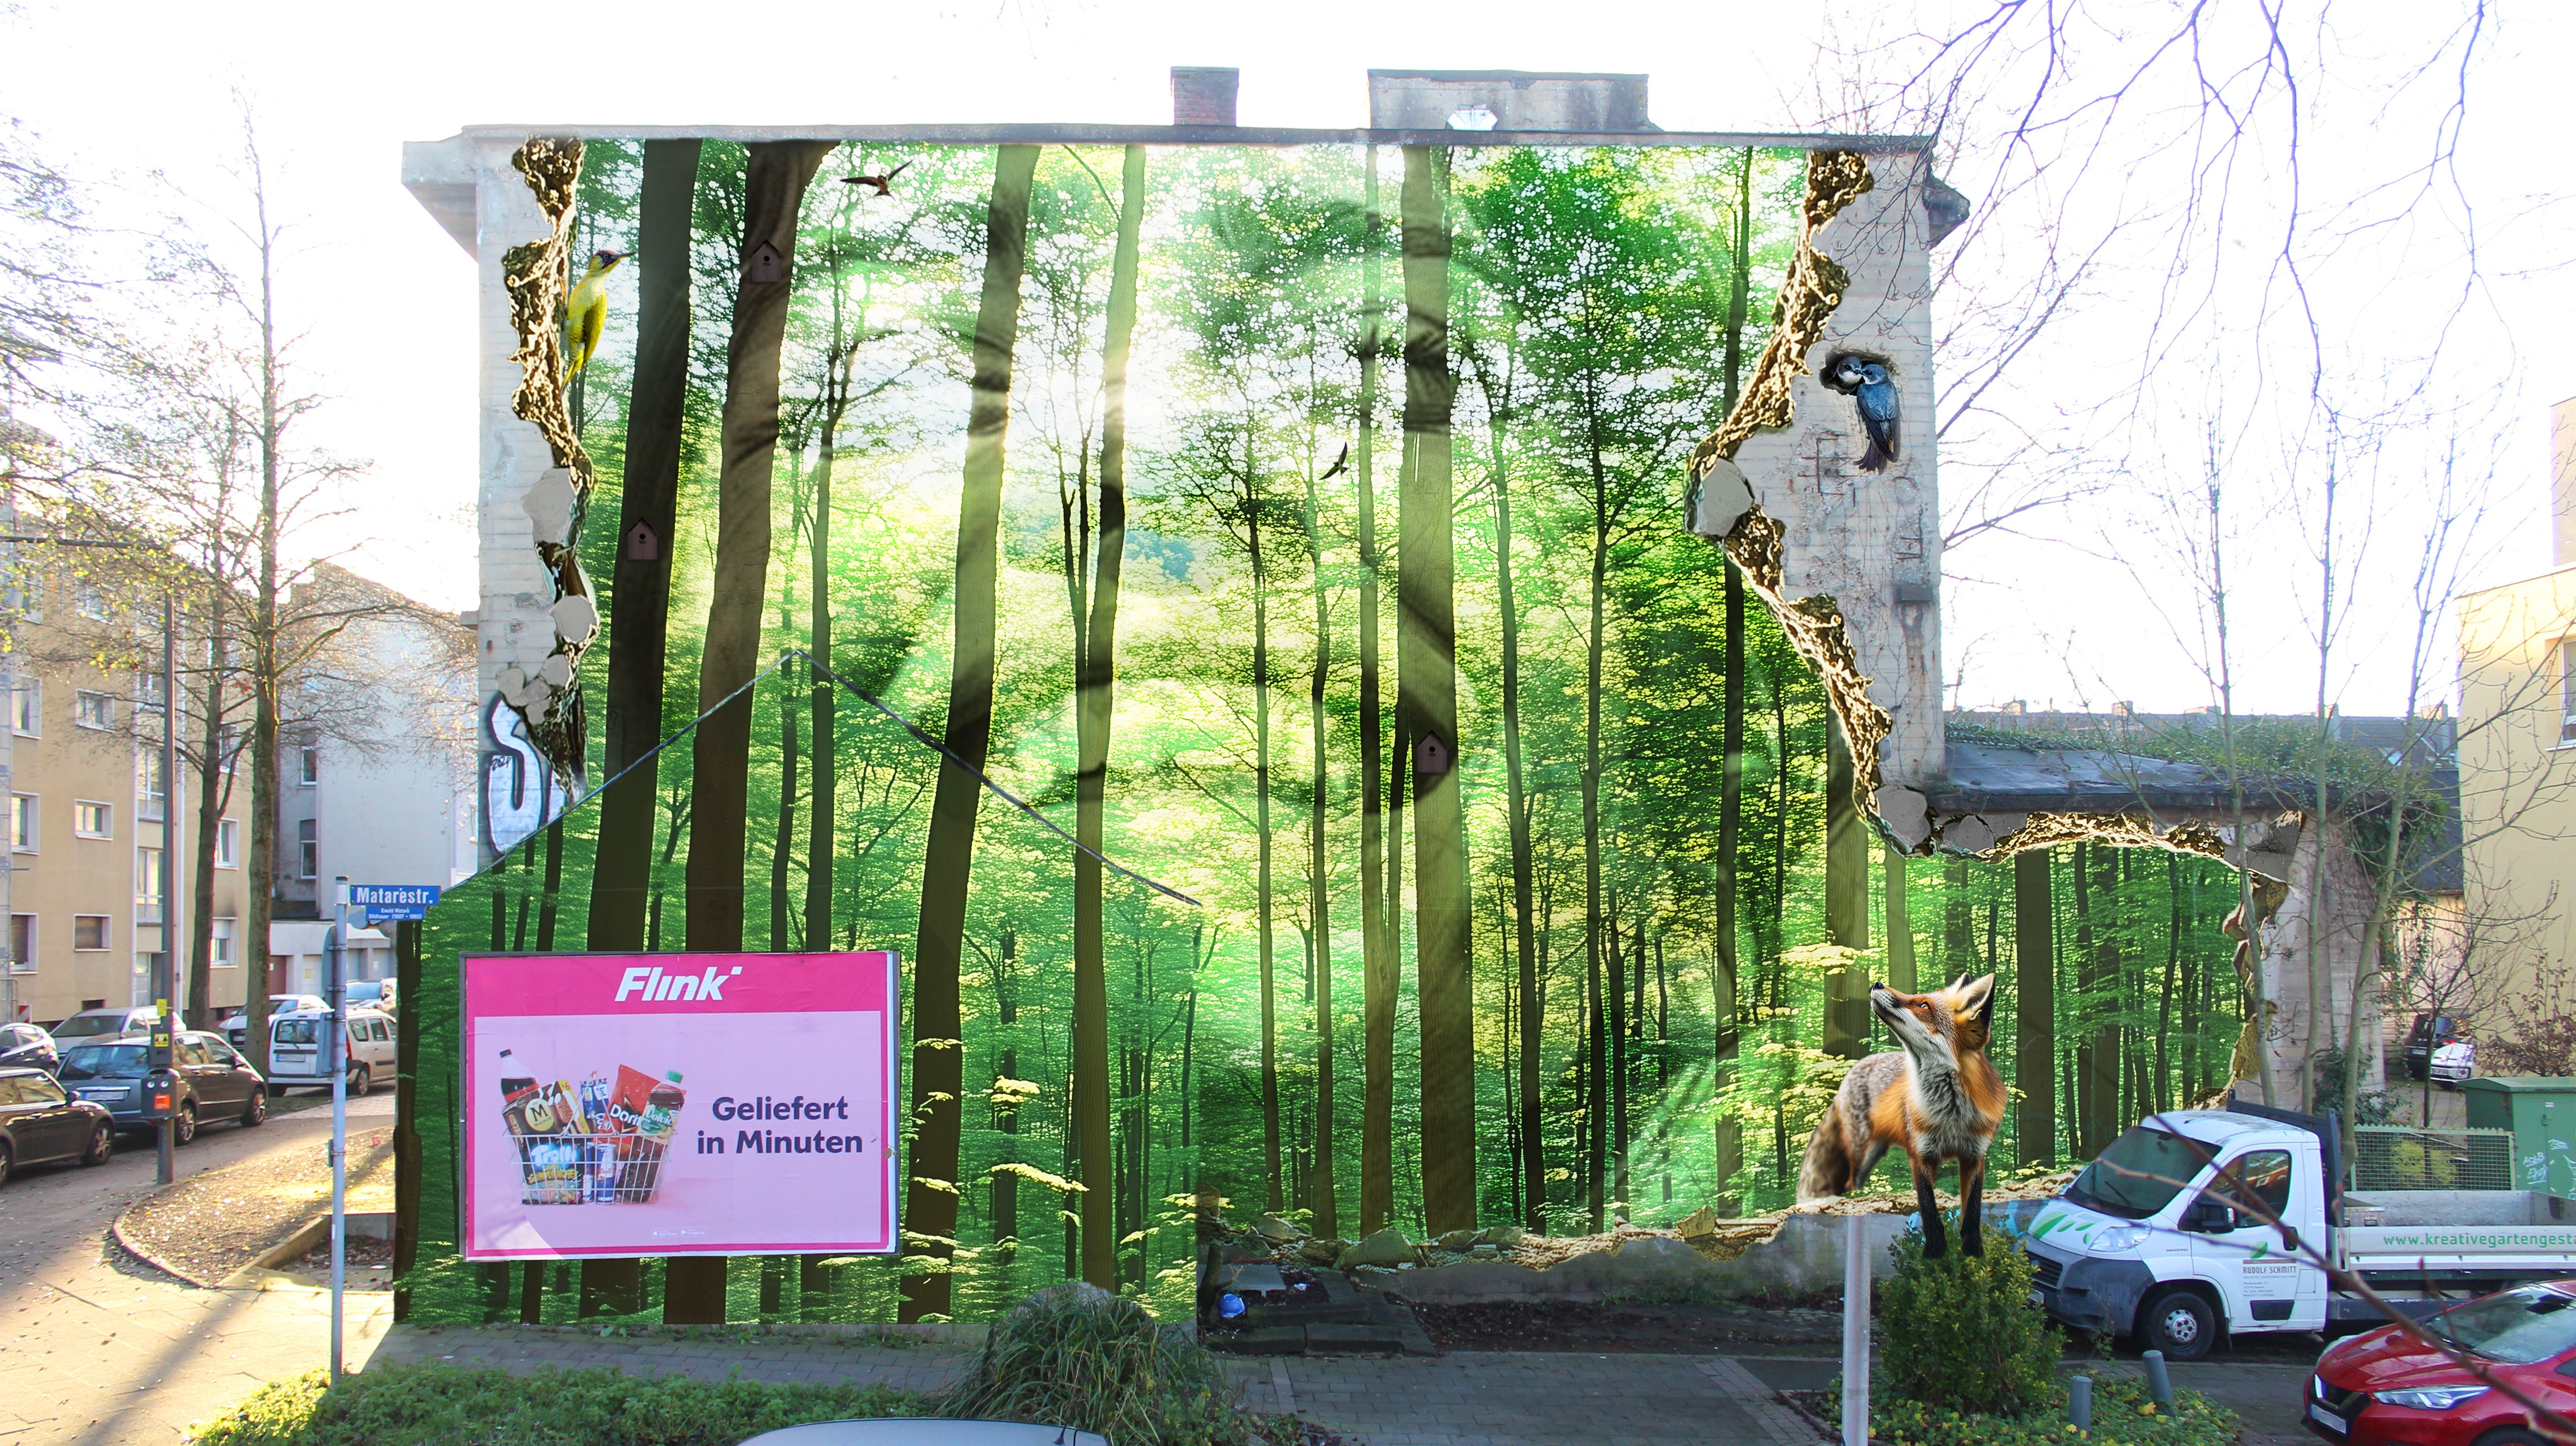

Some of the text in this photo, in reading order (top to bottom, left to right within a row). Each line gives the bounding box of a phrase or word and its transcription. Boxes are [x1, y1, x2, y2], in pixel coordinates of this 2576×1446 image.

[614, 966, 742, 1002] Flink
[530, 1104, 548, 1121] M
[712, 1096, 848, 1121] Geliefert
[698, 1130, 863, 1154] in Minuten
